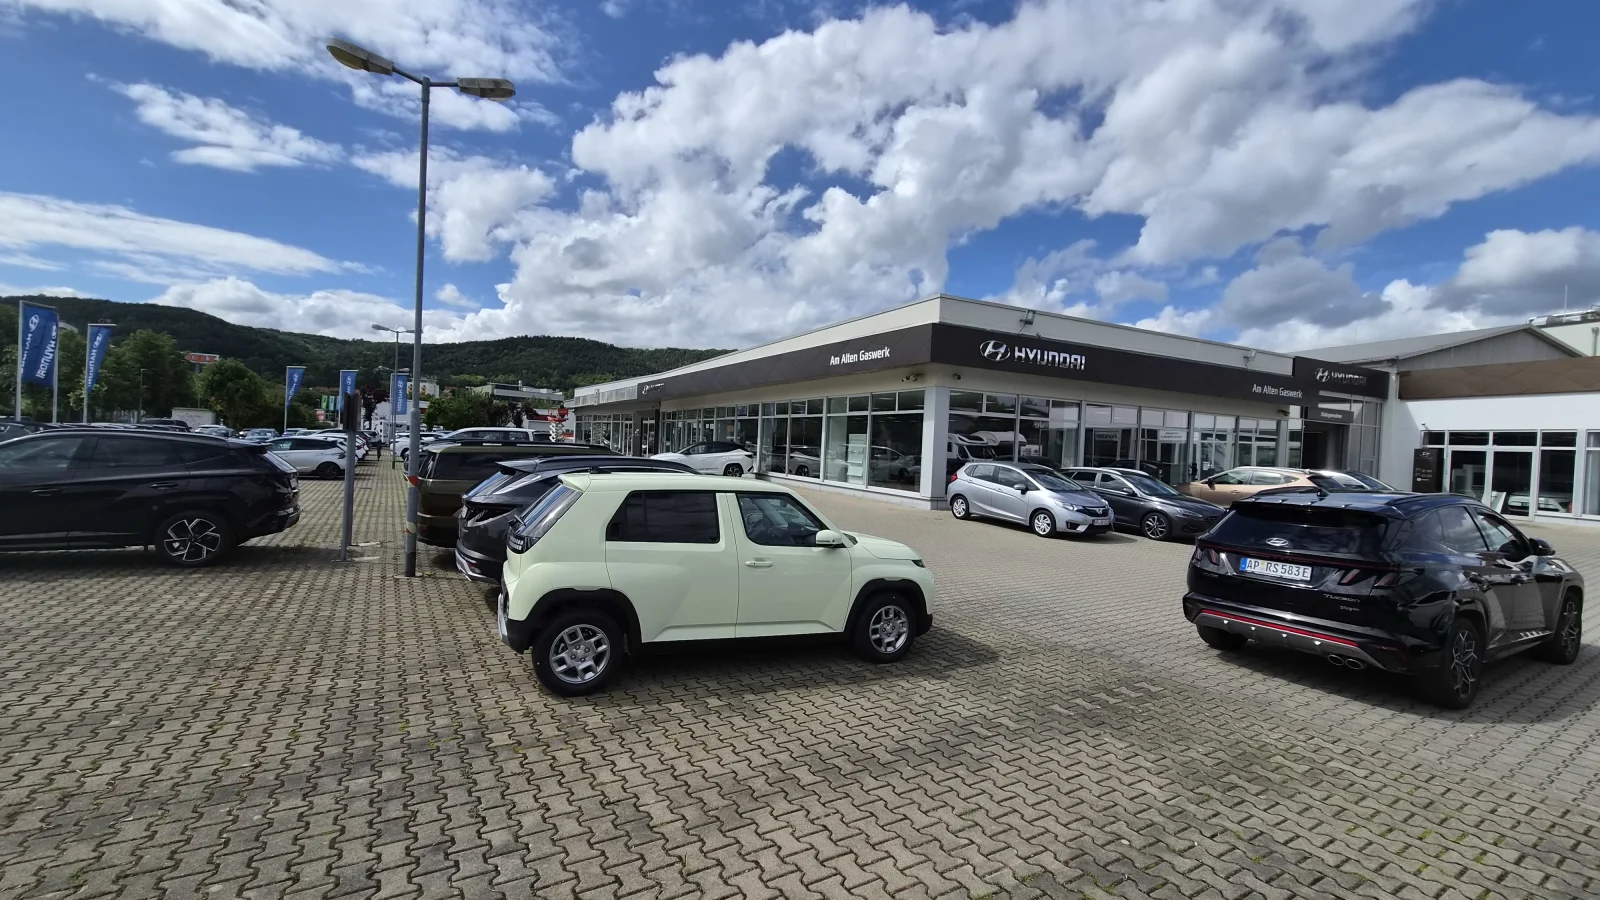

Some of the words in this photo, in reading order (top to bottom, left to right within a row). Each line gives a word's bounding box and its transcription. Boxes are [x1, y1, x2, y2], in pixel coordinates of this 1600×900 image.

[829, 355, 840, 366] Am
[841, 353, 858, 364] Alten
[859, 346, 891, 361] Gaswerk
[1014, 346, 1086, 371] HYUNDAI
[1252, 384, 1262, 394] Am
[1263, 385, 1278, 395] Alten
[1279, 387, 1303, 399] Gaswerk
[1246, 559, 1260, 570] AP
[1265, 562, 1279, 573] RS
